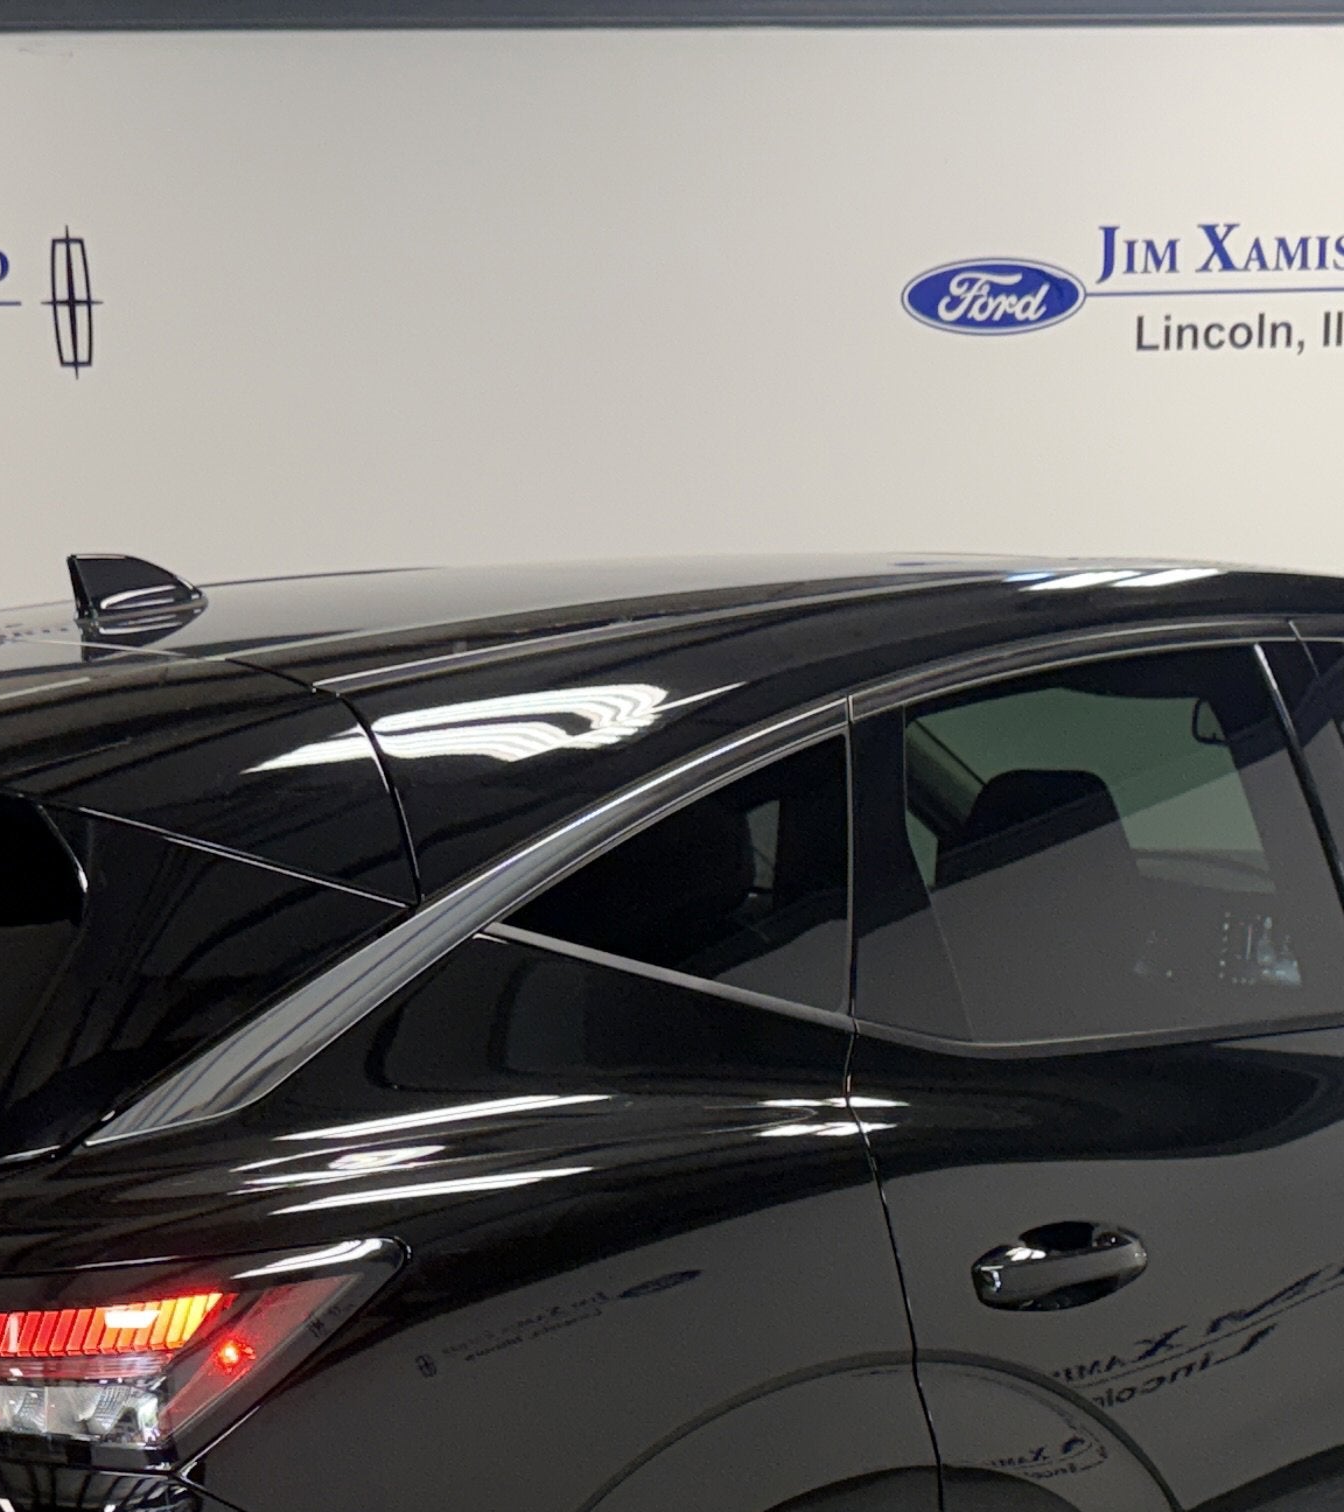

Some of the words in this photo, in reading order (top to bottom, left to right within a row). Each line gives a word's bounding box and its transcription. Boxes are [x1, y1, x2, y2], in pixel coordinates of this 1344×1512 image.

[1096, 226, 1179, 284] JIM
[936, 271, 1048, 323] Ford
[1136, 313, 1305, 354] Lincoln,
